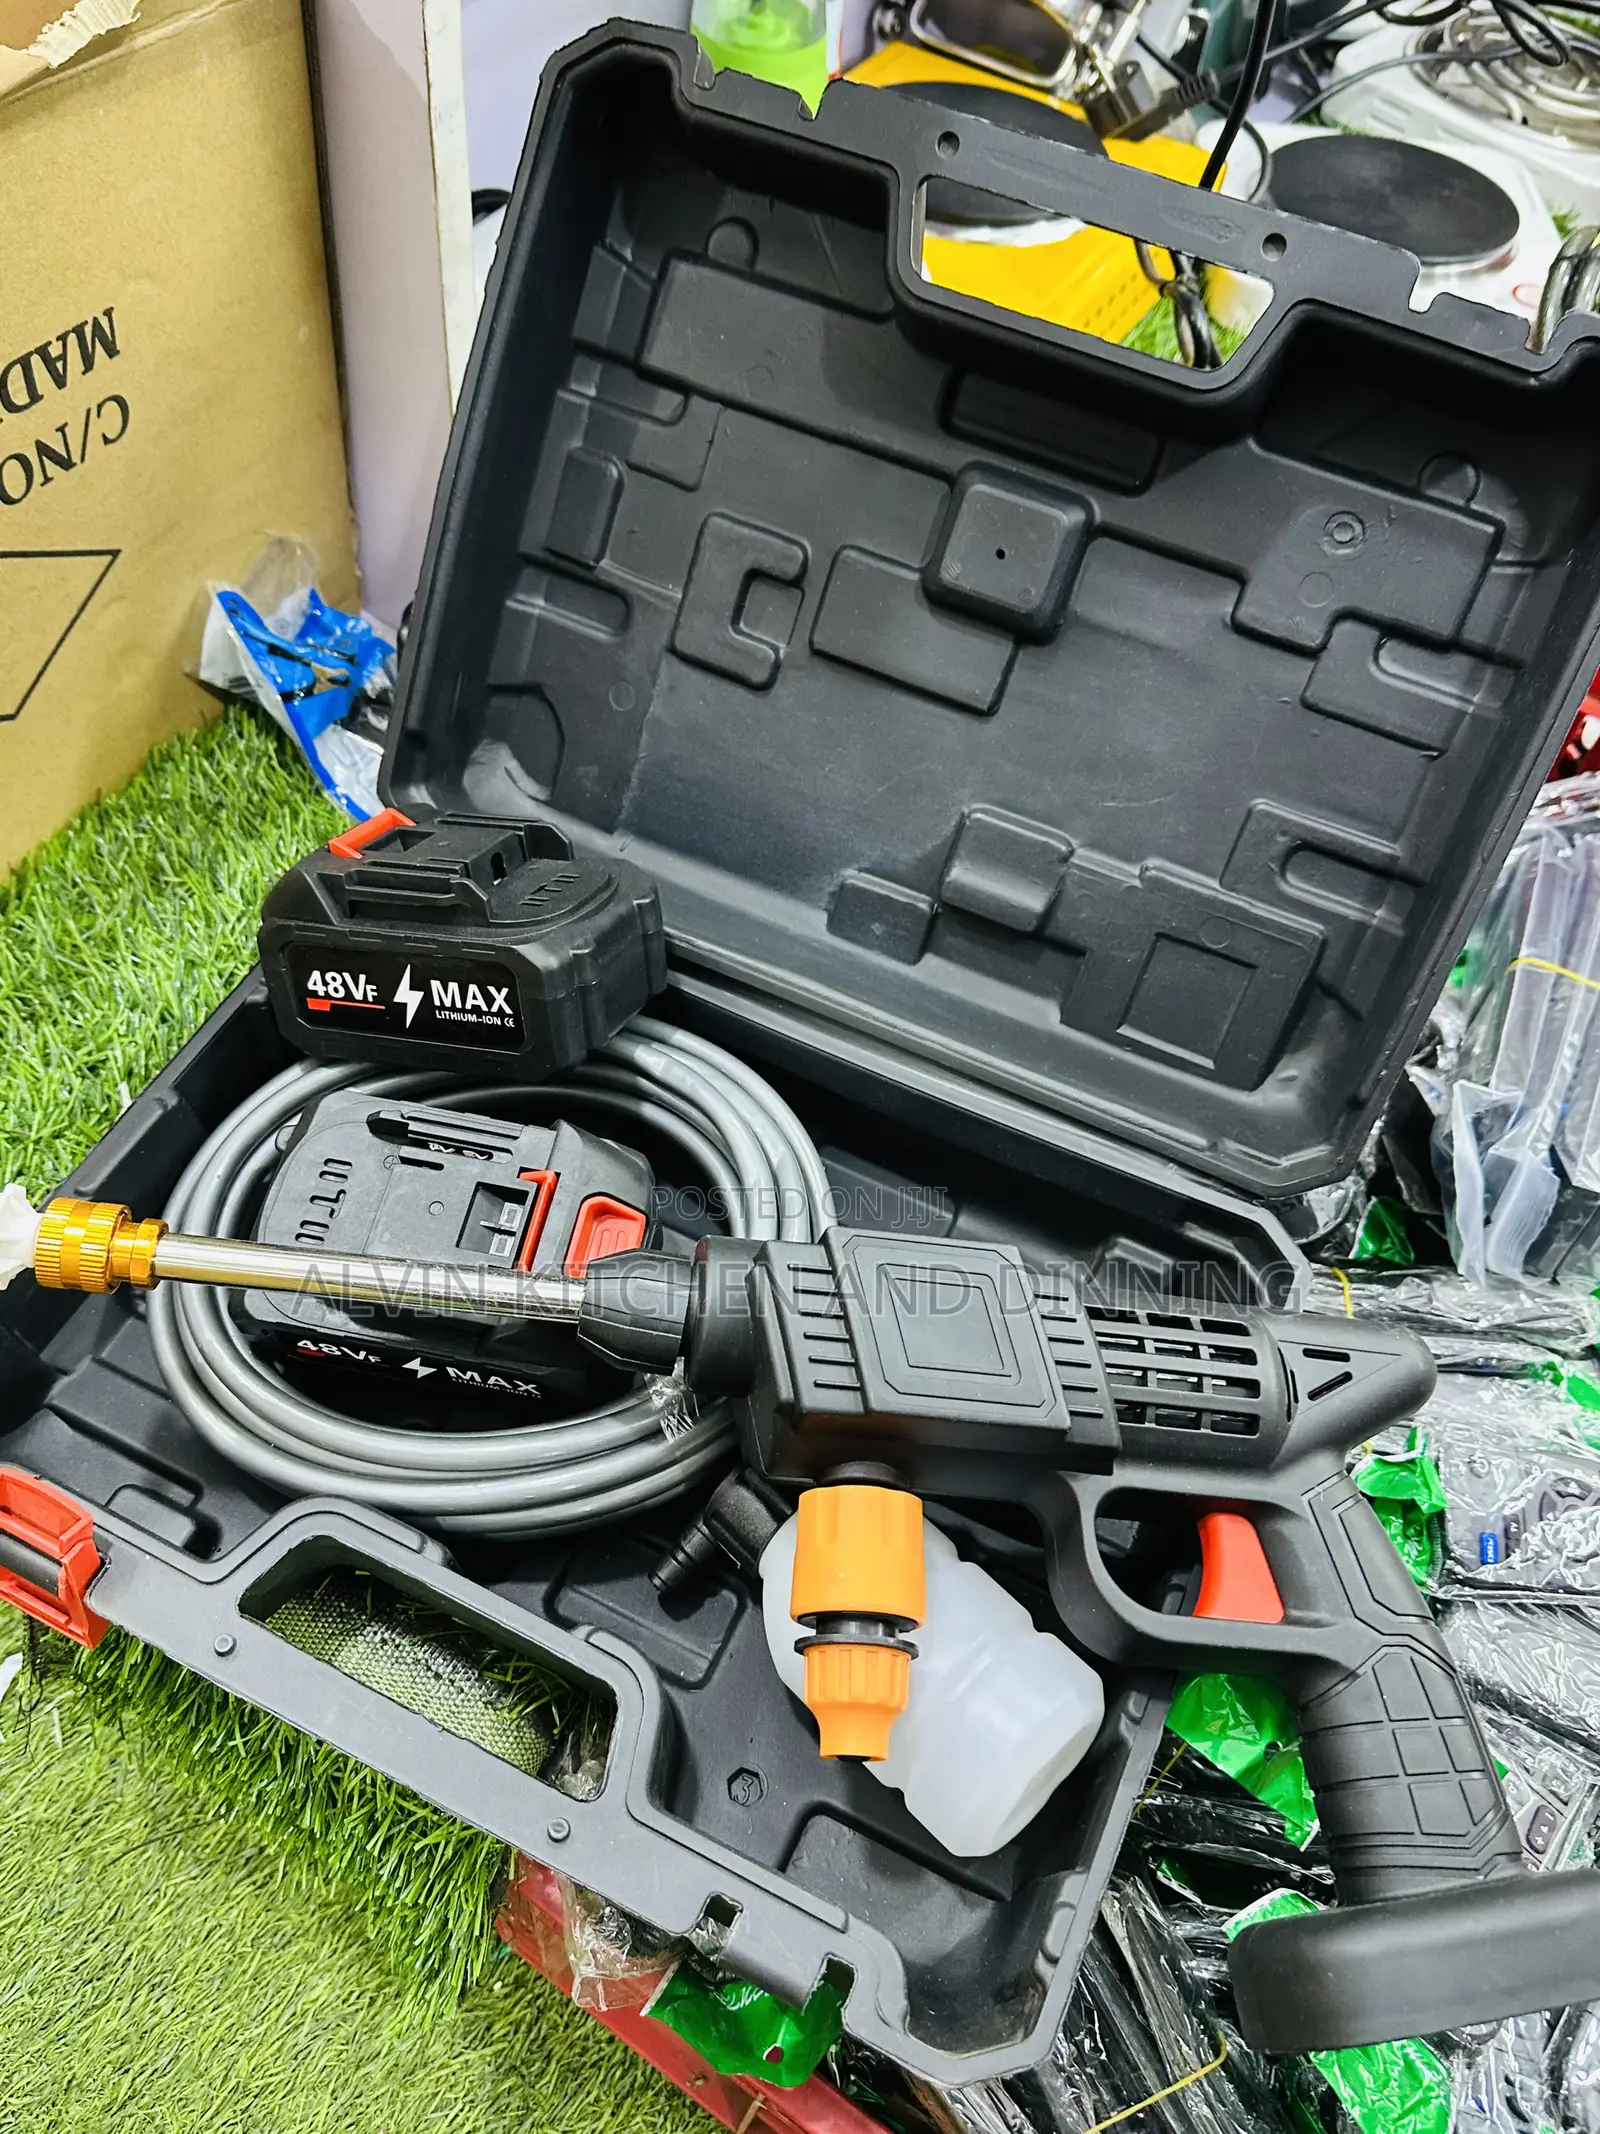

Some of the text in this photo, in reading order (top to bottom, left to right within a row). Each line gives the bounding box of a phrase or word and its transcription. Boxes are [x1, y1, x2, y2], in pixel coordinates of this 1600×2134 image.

[0, 306, 120, 423] MAD
[430, 979, 514, 1014] MAX
[435, 1009, 502, 1026] LITHIUM-ION
[446, 1366, 542, 1395] MAX
